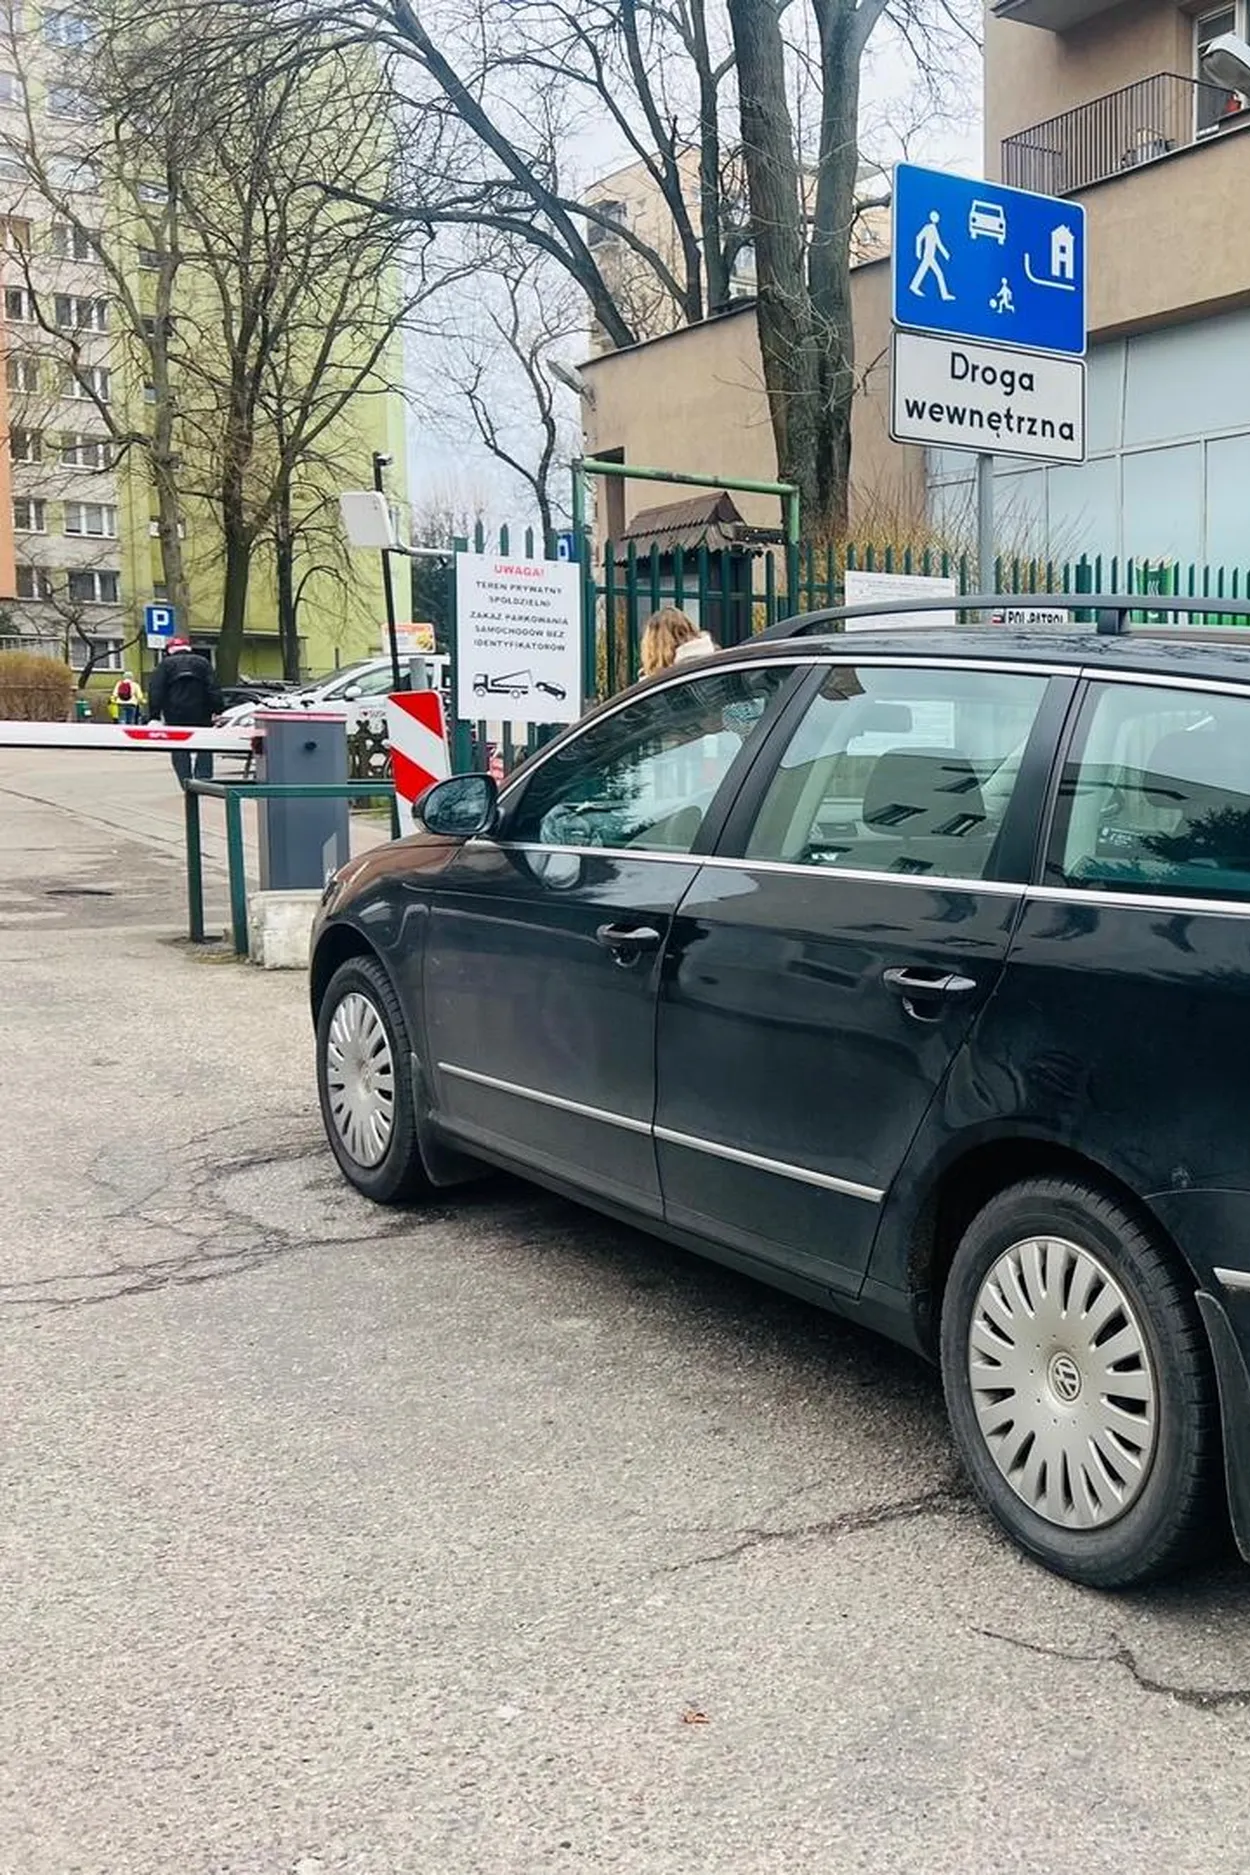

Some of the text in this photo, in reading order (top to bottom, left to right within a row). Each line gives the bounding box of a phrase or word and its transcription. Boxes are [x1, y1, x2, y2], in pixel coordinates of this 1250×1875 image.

[951, 352, 1035, 396] Droga
[905, 398, 1074, 442] wewnętrzna
[494, 564, 545, 577] UWAGA!
[475, 580, 508, 591] TEREN
[152, 609, 170, 631] P
[469, 610, 569, 626] ZAKAZ PARKOWANIA
